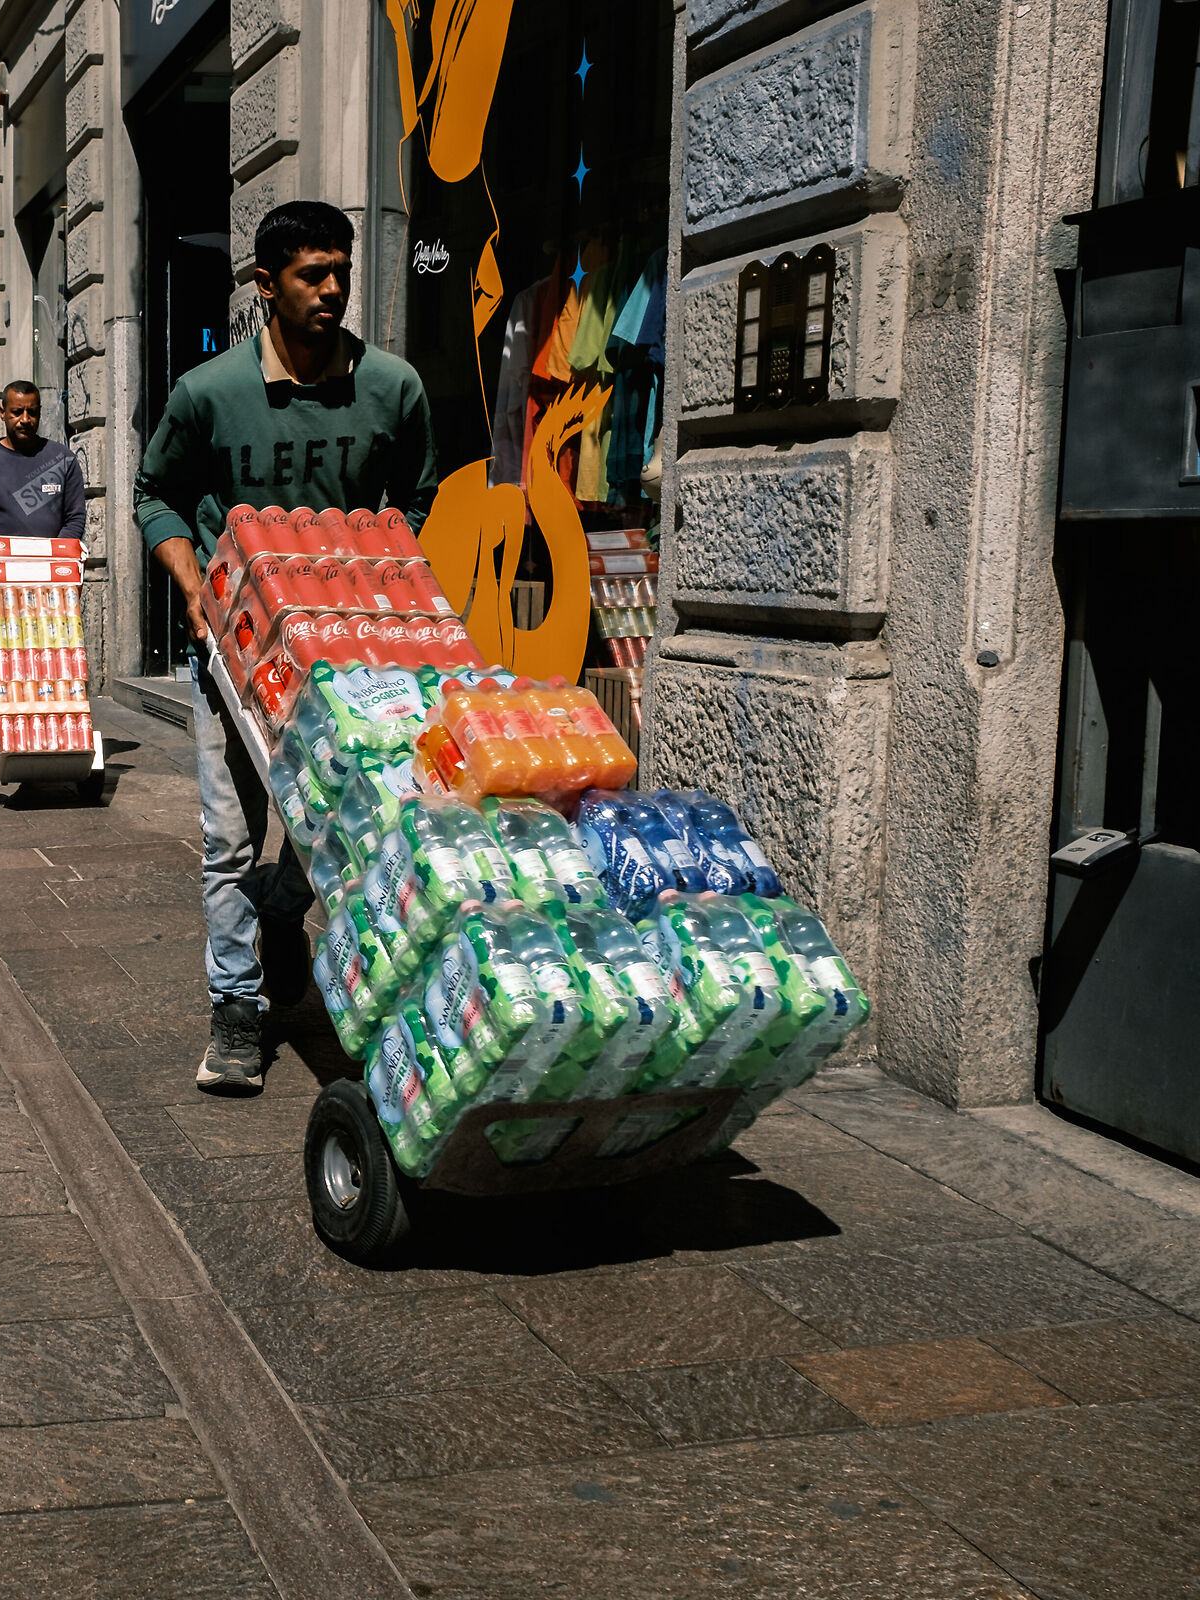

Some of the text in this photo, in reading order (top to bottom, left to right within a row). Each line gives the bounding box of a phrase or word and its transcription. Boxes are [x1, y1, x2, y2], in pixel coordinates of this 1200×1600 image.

[359, 687, 410, 709] ECOGREEN
[375, 893, 388, 915] SAN
[439, 1004, 451, 1030] SAN
